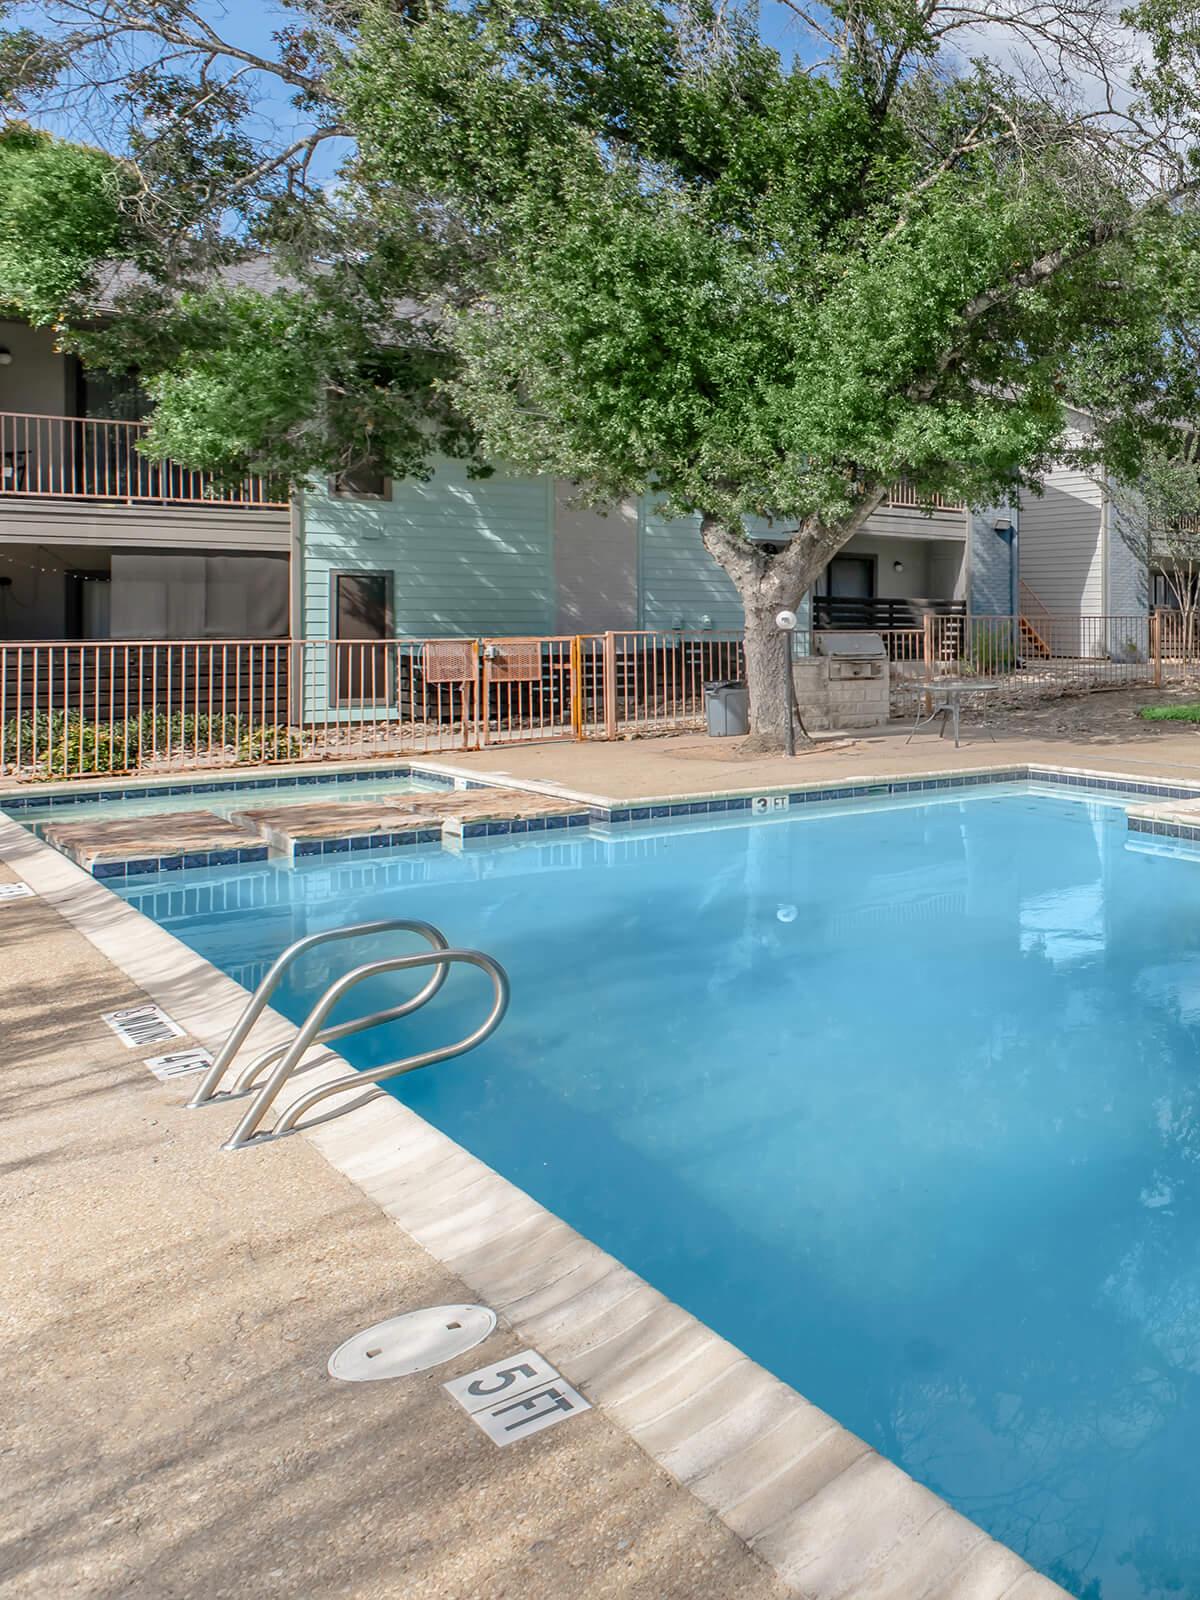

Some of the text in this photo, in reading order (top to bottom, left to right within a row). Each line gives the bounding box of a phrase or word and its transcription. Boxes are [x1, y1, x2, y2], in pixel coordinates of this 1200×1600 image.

[164, 1059, 212, 1076] FT
[468, 1363, 575, 1431] 5 FT
